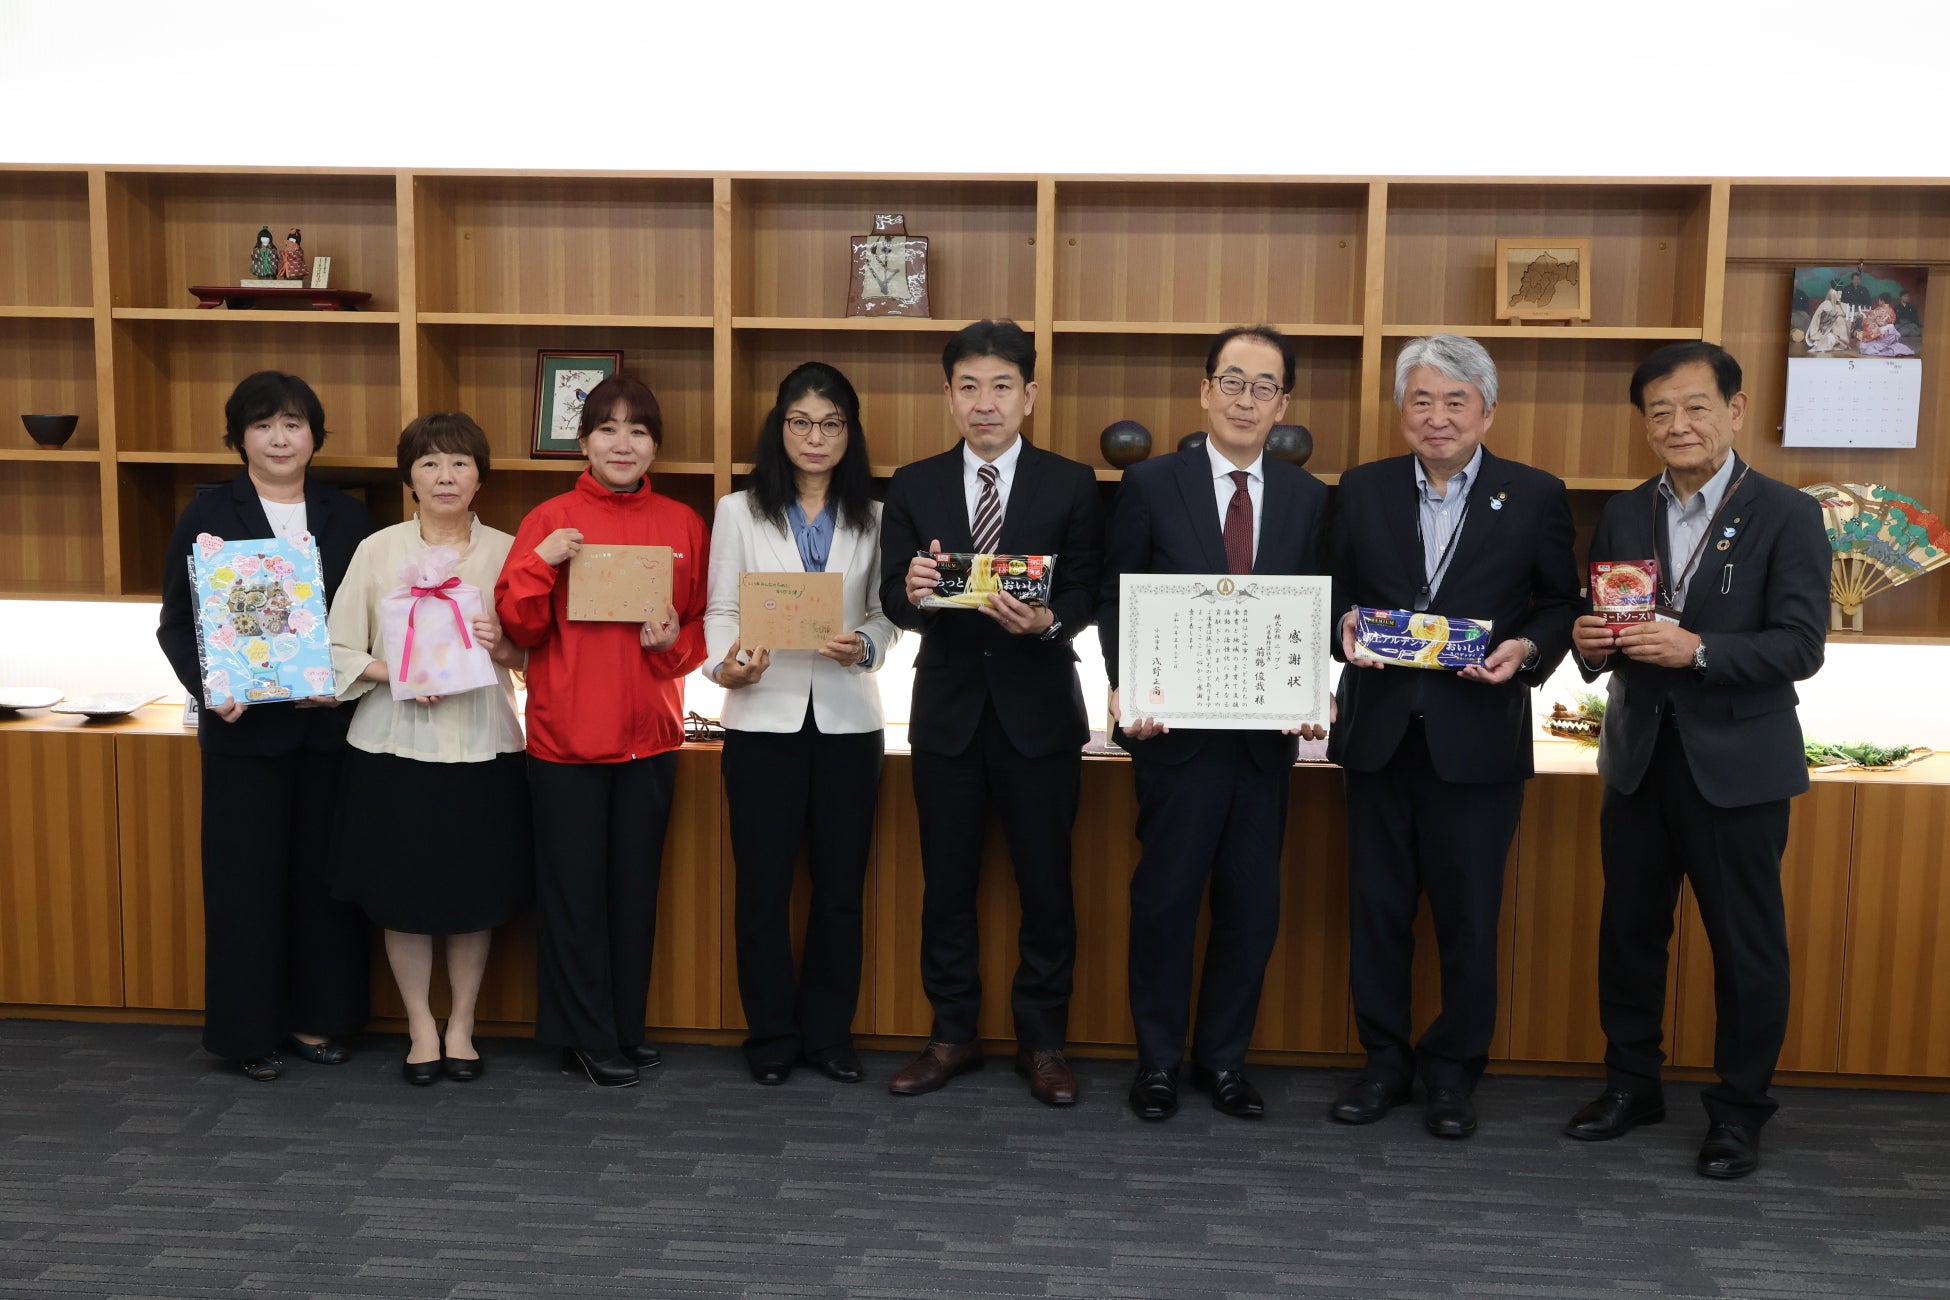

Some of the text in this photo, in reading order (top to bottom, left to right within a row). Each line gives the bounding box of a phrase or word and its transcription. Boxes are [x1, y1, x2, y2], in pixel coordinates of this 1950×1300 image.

[1848, 360, 1855, 370] 5
[1003, 580, 1046, 591] おいしい
[1602, 612, 1647, 623] ミートソース
[1446, 642, 1485, 653] おいしい
[1287, 629, 1302, 688] 感謝状
